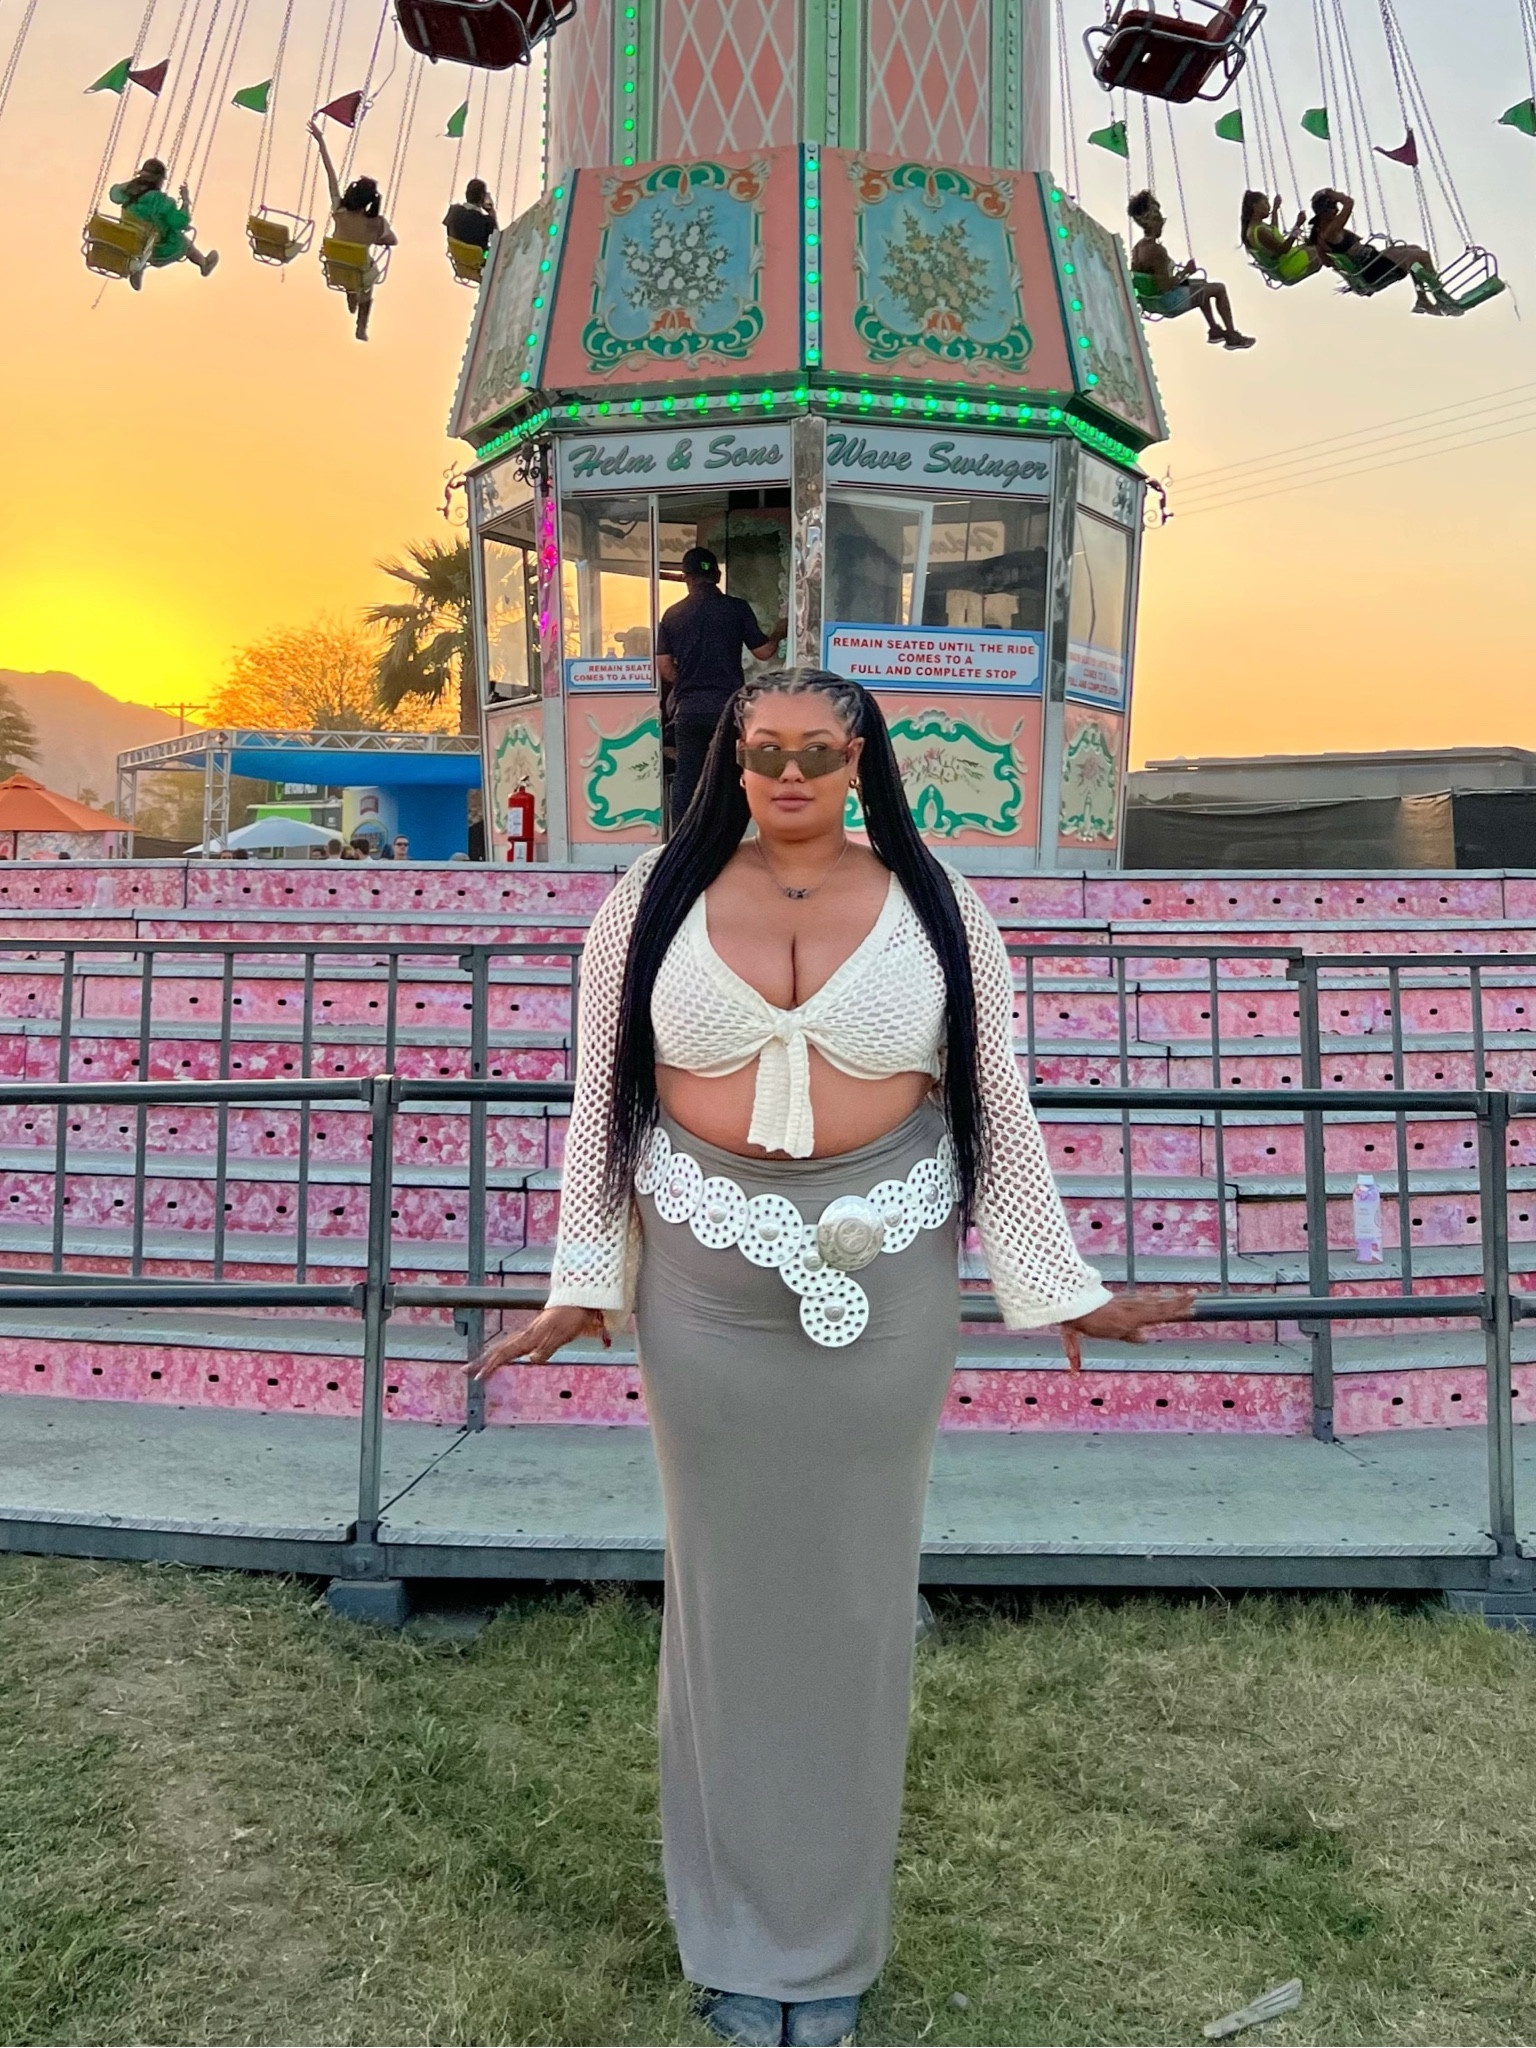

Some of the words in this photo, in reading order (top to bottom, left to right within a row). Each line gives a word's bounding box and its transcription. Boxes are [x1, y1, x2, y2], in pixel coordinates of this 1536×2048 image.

[568, 444, 656, 478] Helm
[667, 438, 692, 471] &
[704, 435, 784, 469] Sons
[826, 433, 913, 471] Wave
[923, 441, 1049, 488] Swinger
[833, 637, 883, 649] REMAIN
[887, 640, 935, 650] SEATED
[939, 642, 975, 652] UNTIL
[979, 643, 1004, 654] THE
[1007, 645, 1035, 655] RIDE
[898, 653, 941, 664] COMES
[945, 655, 961, 664] TO
[964, 656, 973, 665] A
[589, 664, 623, 672] REMAIN
[850, 664, 881, 674] FULL
[886, 665, 912, 675] AND
[916, 667, 982, 678] COMPLETE
[985, 669, 1017, 679] STOP
[574, 674, 604, 682] COMES
